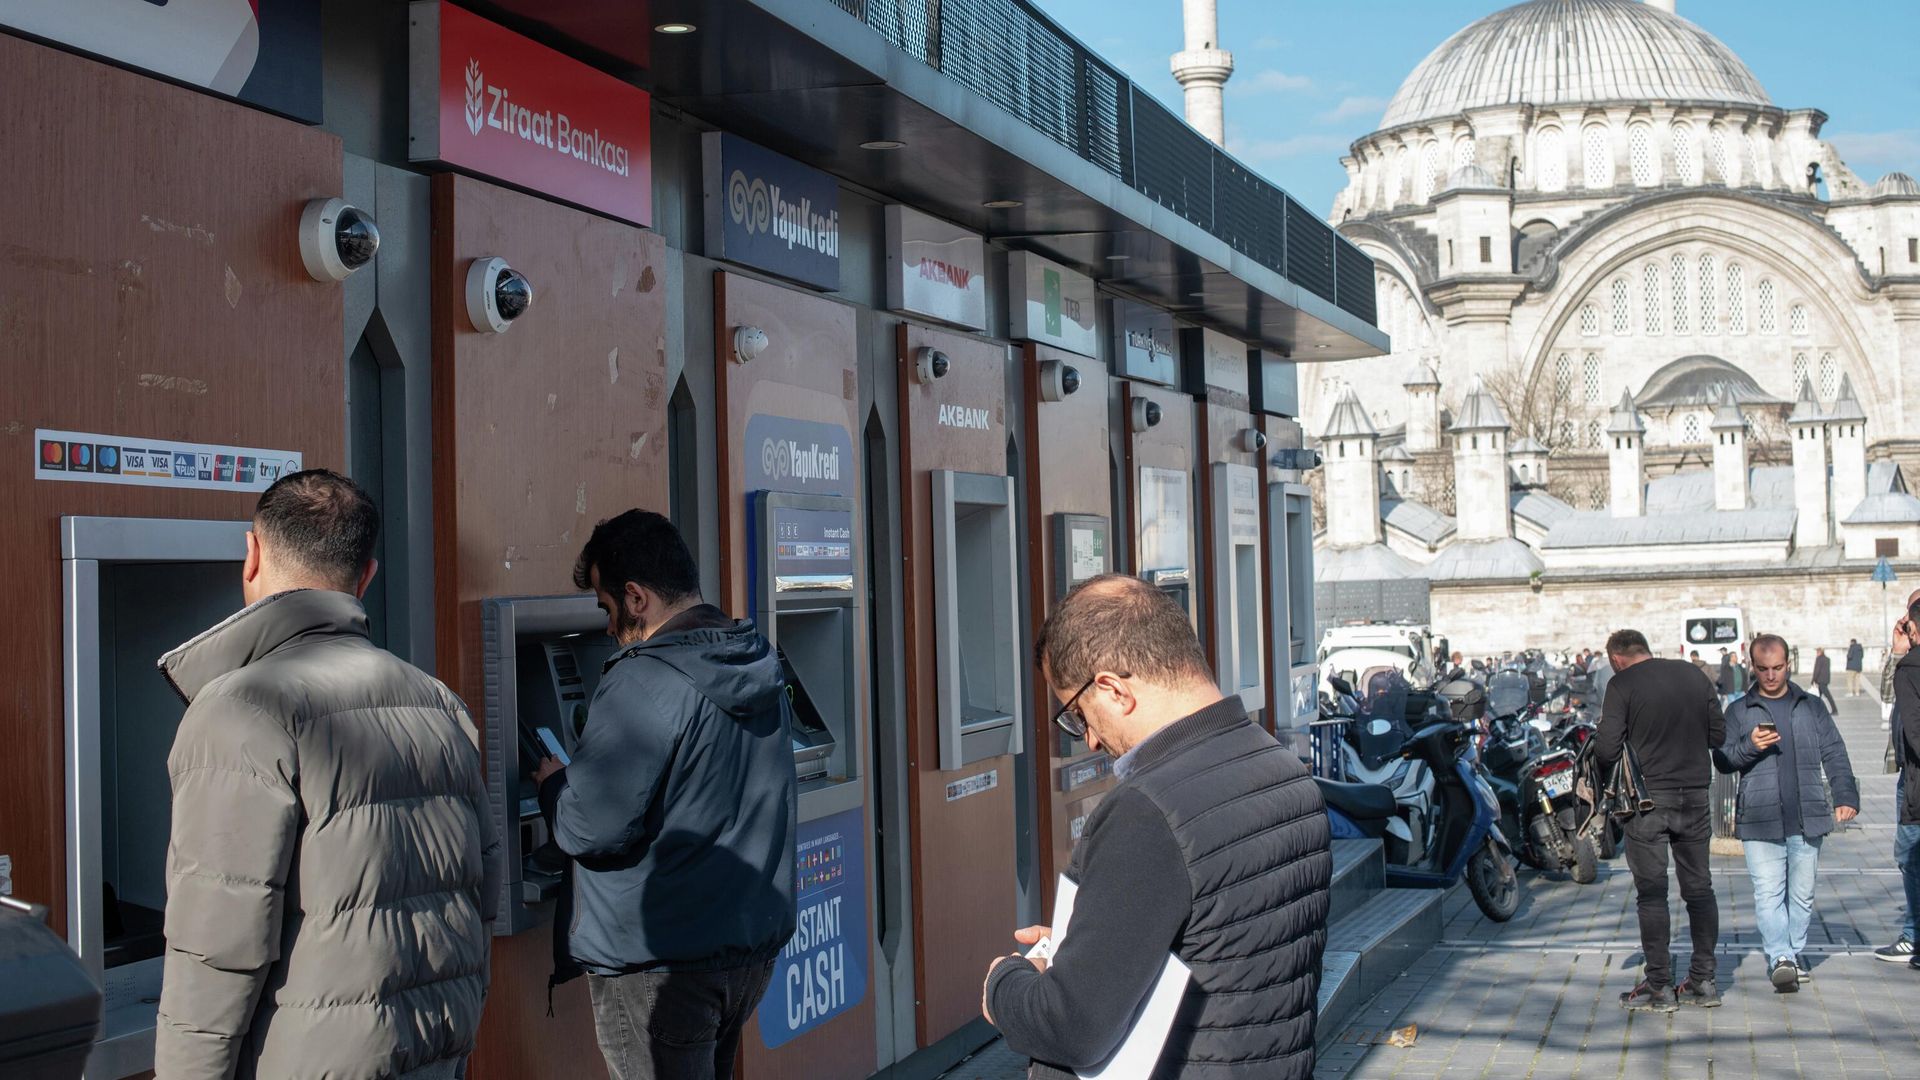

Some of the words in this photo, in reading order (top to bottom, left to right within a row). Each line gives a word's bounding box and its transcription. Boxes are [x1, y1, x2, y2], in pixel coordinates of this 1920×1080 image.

[487, 85, 553, 149] Ziraat
[557, 113, 629, 177] Bankası
[770, 184, 839, 258] YapıKredi
[920, 257, 970, 290] AKBANK
[1064, 297, 1081, 322] TEB
[939, 404, 990, 430] AKBANK
[125, 454, 145, 469] VISA
[151, 456, 169, 470] VISA
[180, 465, 196, 477] PLUS
[260, 461, 281, 481] troy
[789, 440, 839, 484] YapıKredi
[786, 943, 845, 1030] CASH
